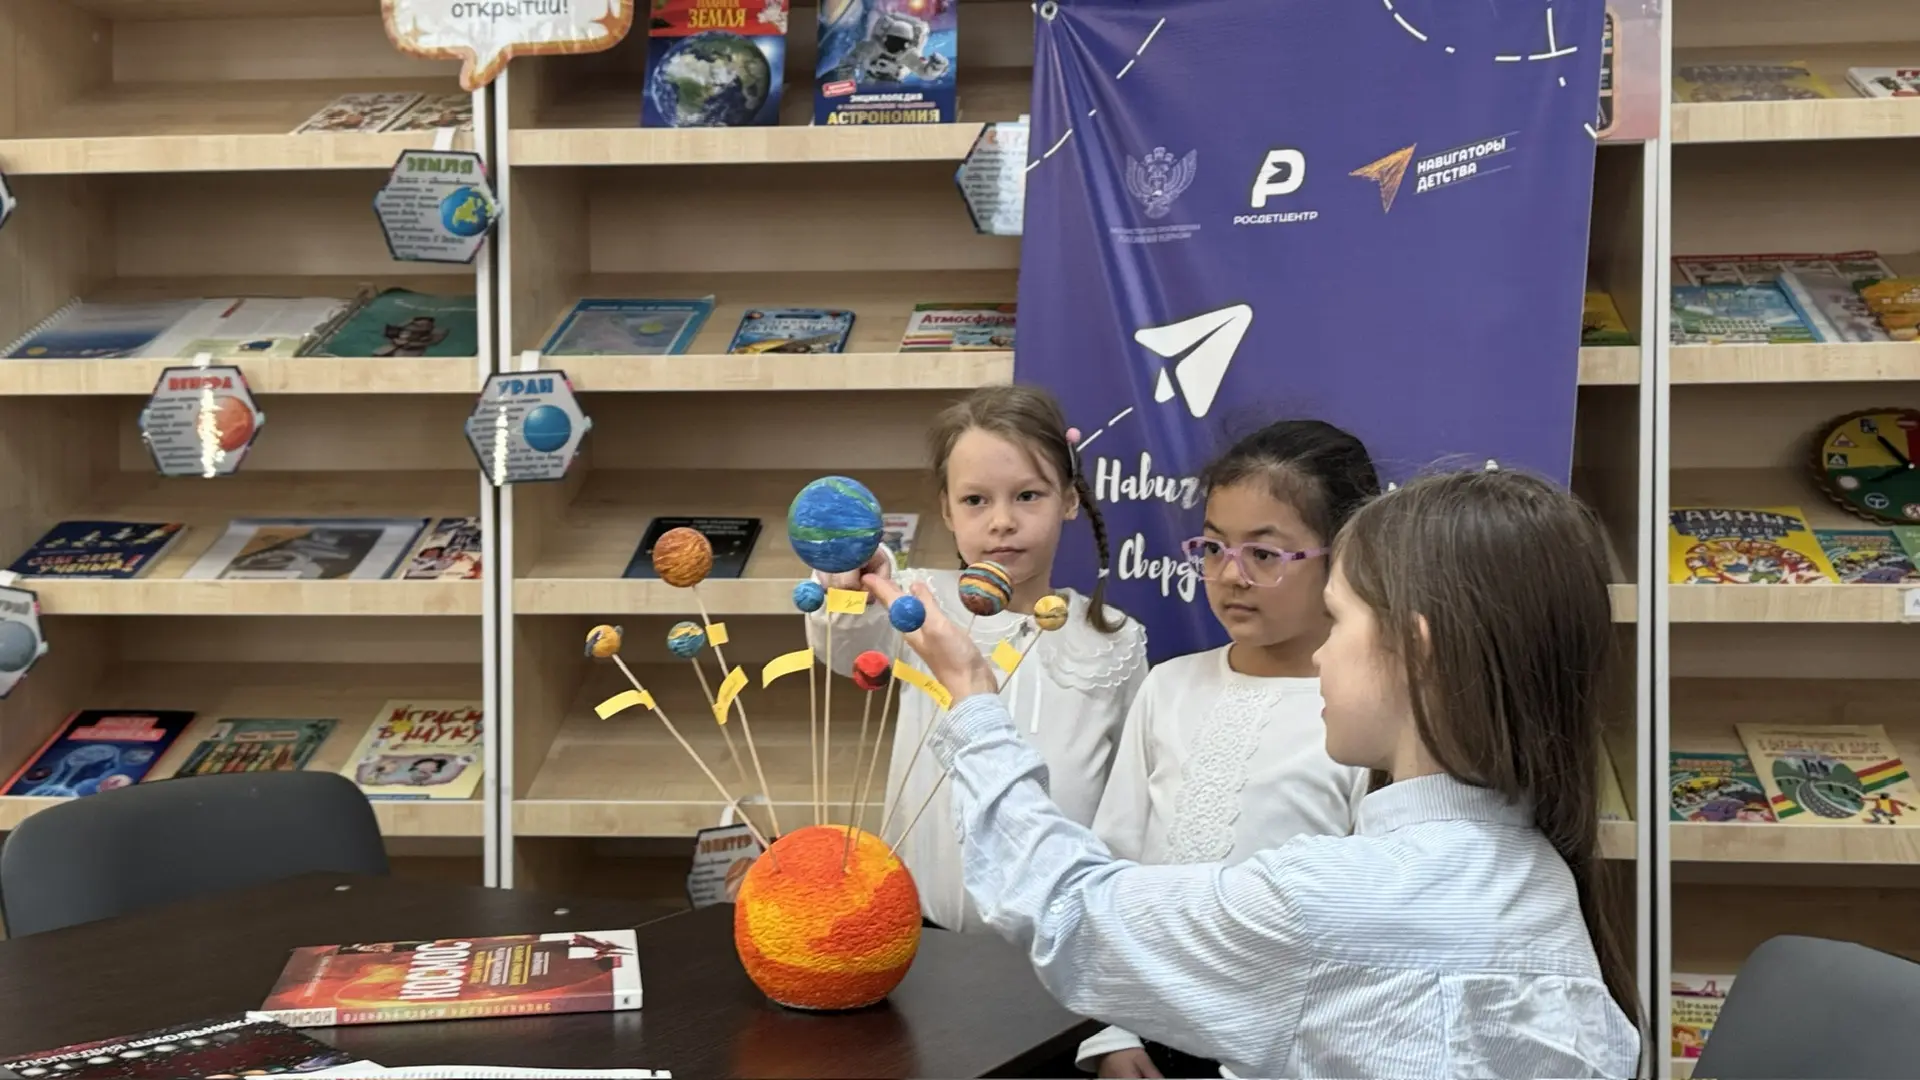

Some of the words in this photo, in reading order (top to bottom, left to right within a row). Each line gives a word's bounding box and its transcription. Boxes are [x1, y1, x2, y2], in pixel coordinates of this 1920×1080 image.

[687, 8, 747, 28] ЗЕМЛЯ
[827, 109, 941, 125] АСТРОНОМИЯ
[406, 156, 473, 174] ЗЕМЛЯ
[1417, 137, 1506, 174] НАВИГАТОРЫ
[1416, 162, 1477, 194] ДЕТСТВА
[1233, 211, 1318, 225] РОСДЕТЦЕНТР
[498, 378, 554, 396] УРАН
[1095, 451, 1207, 510] Навиг
[398, 941, 472, 1000] КОСМОС
[4, 1043, 126, 1070] КЛОПЕДИЯ
